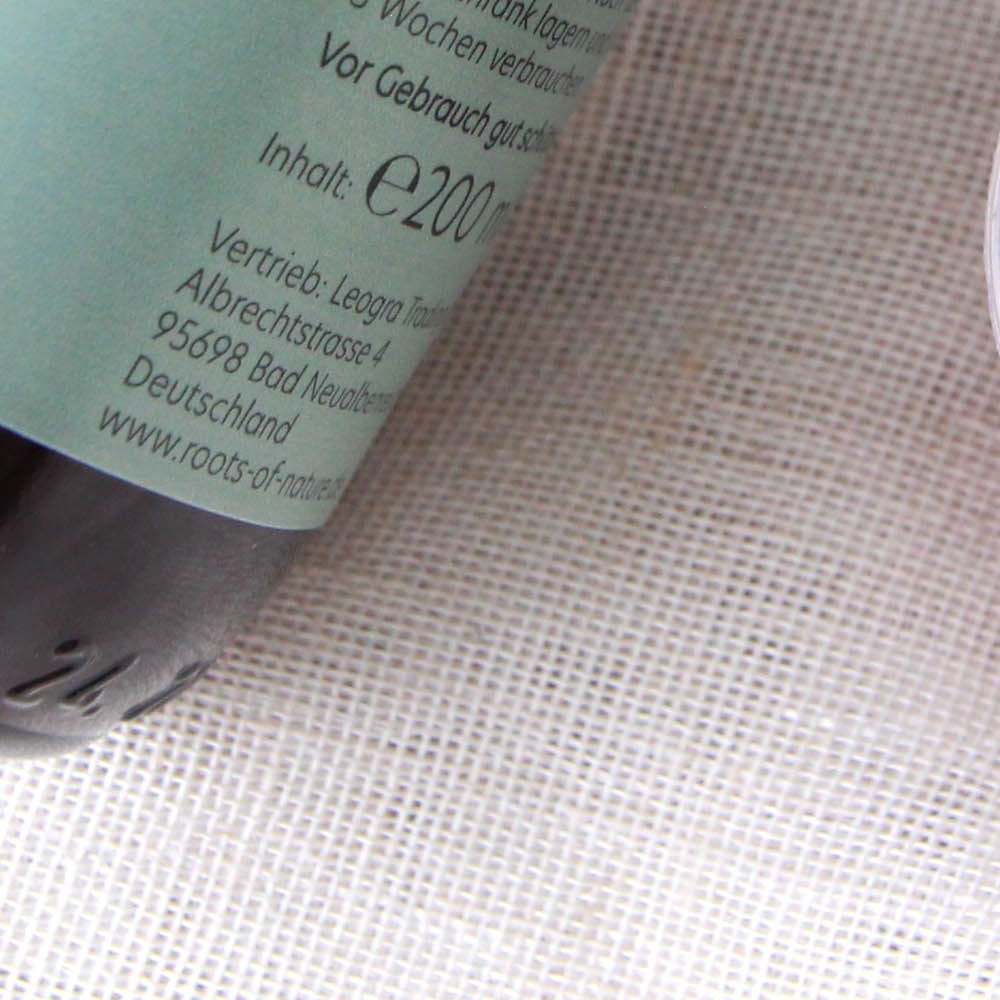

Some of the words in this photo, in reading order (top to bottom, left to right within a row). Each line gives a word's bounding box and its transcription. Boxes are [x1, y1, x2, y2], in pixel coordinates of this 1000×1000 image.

[533, 2, 592, 50] lagern
[319, 31, 376, 85] Vor
[376, 64, 490, 140] Gebrauch
[484, 118, 525, 150] gut
[259, 132, 353, 201] Inhalt:
[209, 219, 328, 300] Vertrieb:
[329, 274, 404, 325] Leogra
[151, 311, 249, 375] 95698
[248, 350, 303, 395] Bad
[176, 267, 375, 366] Albrechtstrasse
[372, 339, 391, 369] 4
[123, 354, 299, 445] Deutschland
